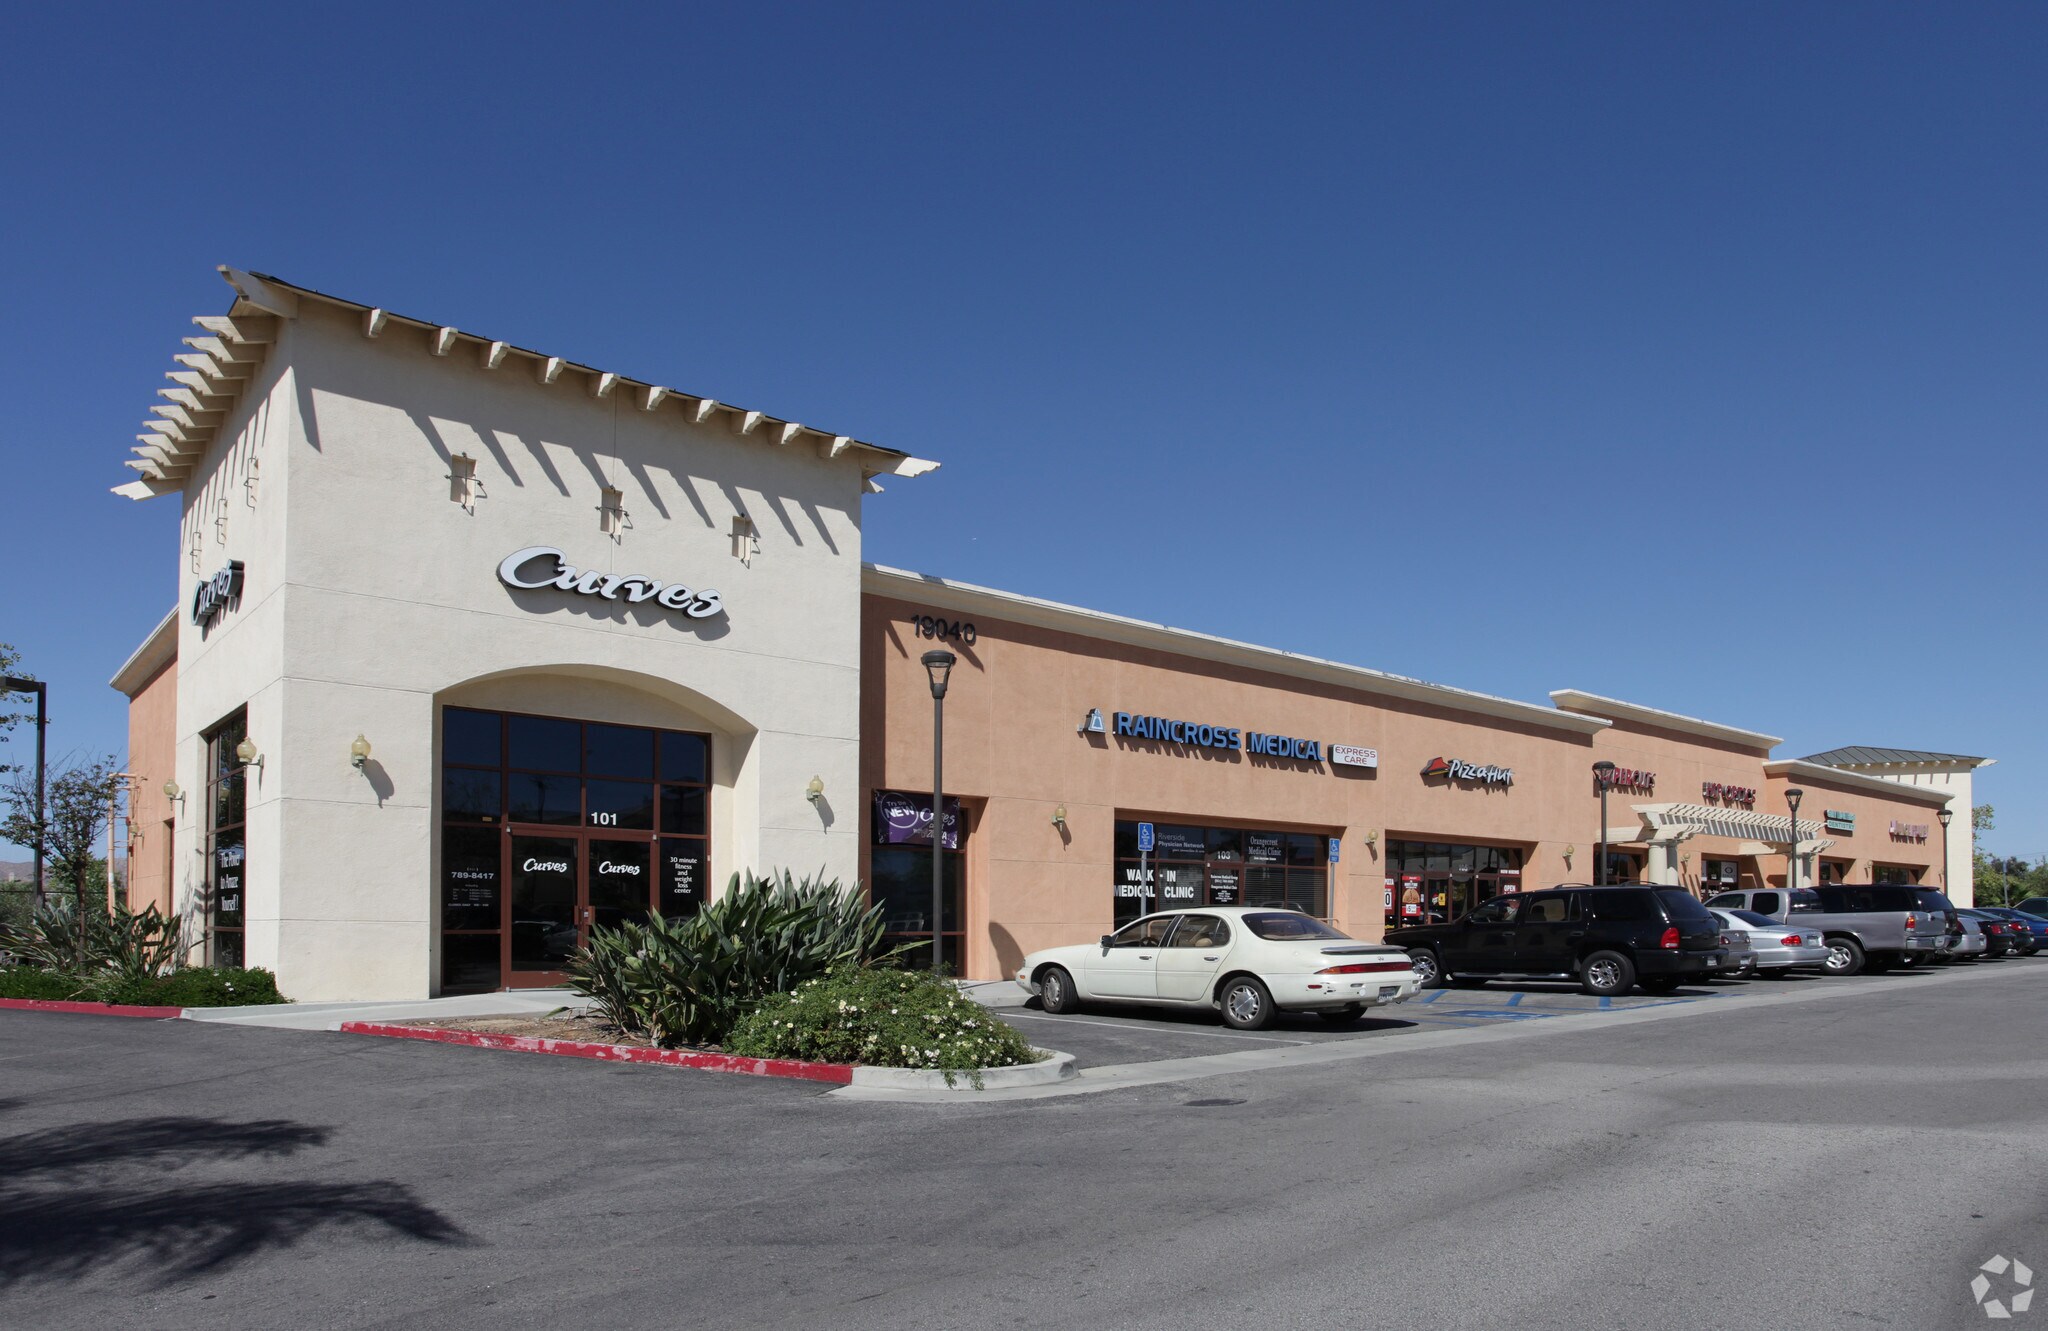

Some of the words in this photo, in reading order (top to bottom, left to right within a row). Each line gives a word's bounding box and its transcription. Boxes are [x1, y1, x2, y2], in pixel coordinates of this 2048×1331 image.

[496, 545, 724, 618] Curves
[191, 559, 240, 626] Curves
[910, 614, 977, 647] 19040
[1114, 711, 1242, 750] RAINCROSS
[1248, 731, 1326, 762] MEDICAL
[1335, 746, 1376, 758] EXPRESS
[1344, 755, 1368, 765] CARE
[1448, 759, 1487, 780] Pizza
[1486, 766, 1515, 785] Hut
[885, 806, 915, 819] NEW
[591, 812, 617, 826] 101
[1157, 832, 1186, 841] Riverside
[1250, 836, 1279, 848] Orangecrest
[1157, 840, 1182, 849] Physician
[1183, 842, 1205, 850] Network
[1217, 851, 1231, 860] 103
[1248, 846, 1267, 856] Medical
[1267, 847, 1282, 857] Clinic
[523, 857, 568, 873] Curves
[598, 860, 641, 876] Curves
[451, 871, 494, 879] 789-8417
[674, 876, 693, 884] weight
[1126, 869, 1155, 882] WAK
[1166, 870, 1176, 882] IN
[1164, 886, 1194, 898] CLINIC
[1503, 884, 1516, 892] OPEN
